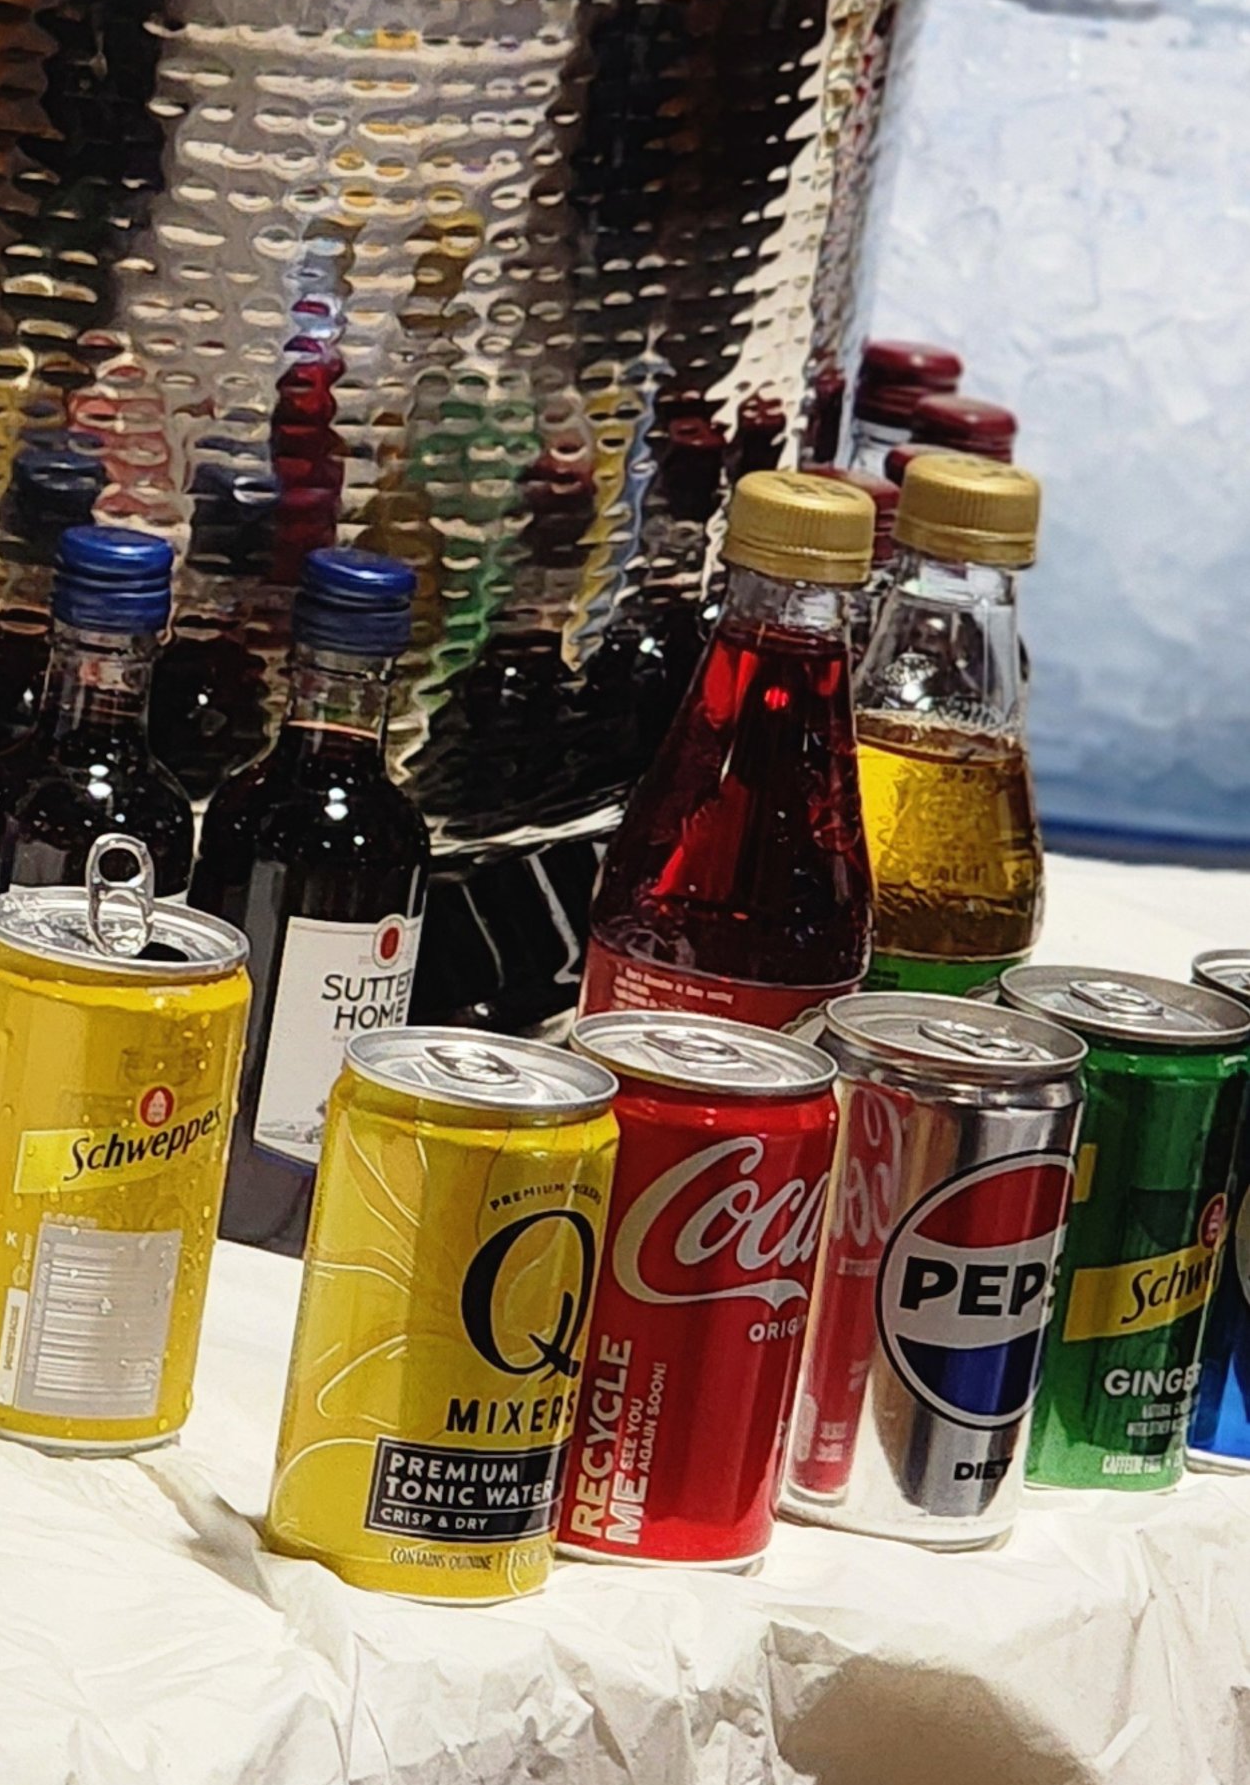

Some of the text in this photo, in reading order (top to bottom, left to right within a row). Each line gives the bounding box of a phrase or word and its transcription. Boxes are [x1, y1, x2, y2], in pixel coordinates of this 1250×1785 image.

[334, 998, 406, 1030] HOME
[489, 1183, 566, 1211] PREMIUM
[461, 1209, 596, 1384] Q
[446, 1389, 577, 1434] MIXERS
[570, 1334, 632, 1538] RECYCLE
[620, 1398, 644, 1471] SEE YOU
[637, 1419, 658, 1473] AGAIN
[388, 1452, 519, 1483] PREMIUM
[385, 1477, 554, 1506] TONIC WATER
[605, 1471, 648, 1545] ME
[380, 1507, 488, 1531] CRISP & DRY
[390, 1547, 446, 1568] CONTAINS
